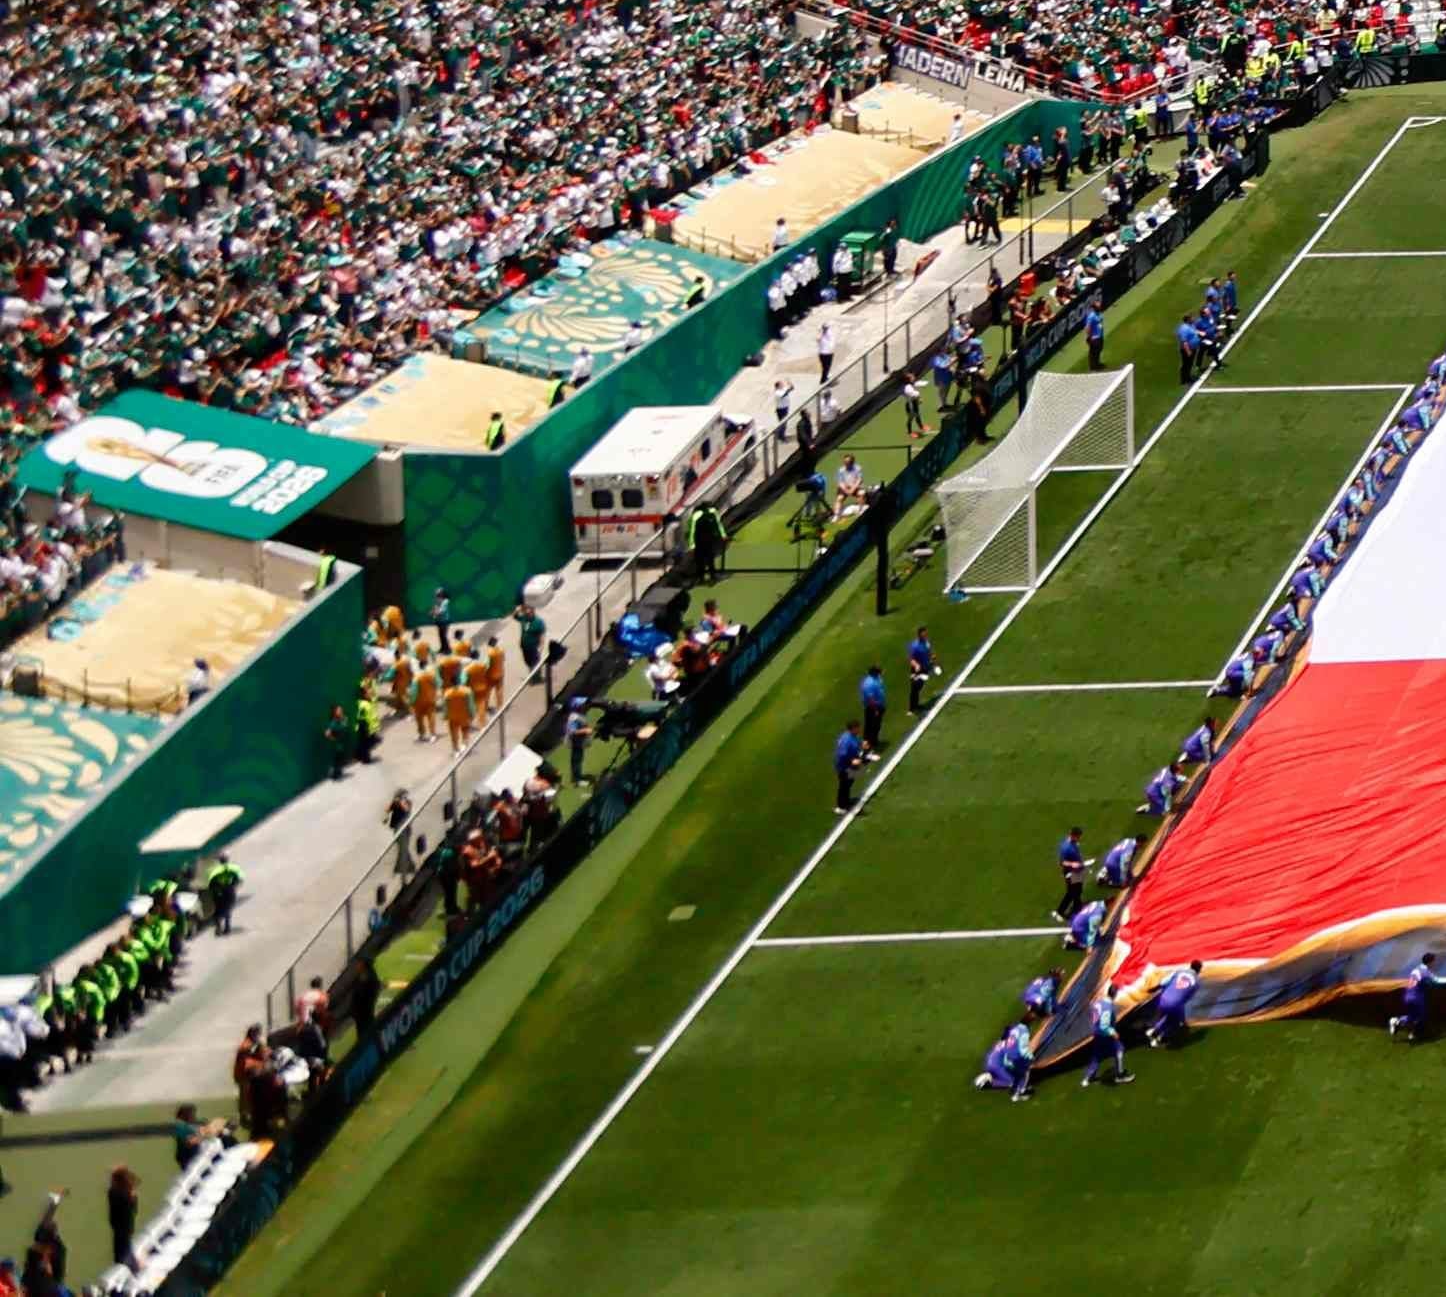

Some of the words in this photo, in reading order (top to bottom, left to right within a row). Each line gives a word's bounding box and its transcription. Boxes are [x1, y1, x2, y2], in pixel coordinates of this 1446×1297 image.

[379, 967, 447, 1053] WORLD
[449, 932, 486, 982] CUP
[485, 862, 546, 937] 2026
